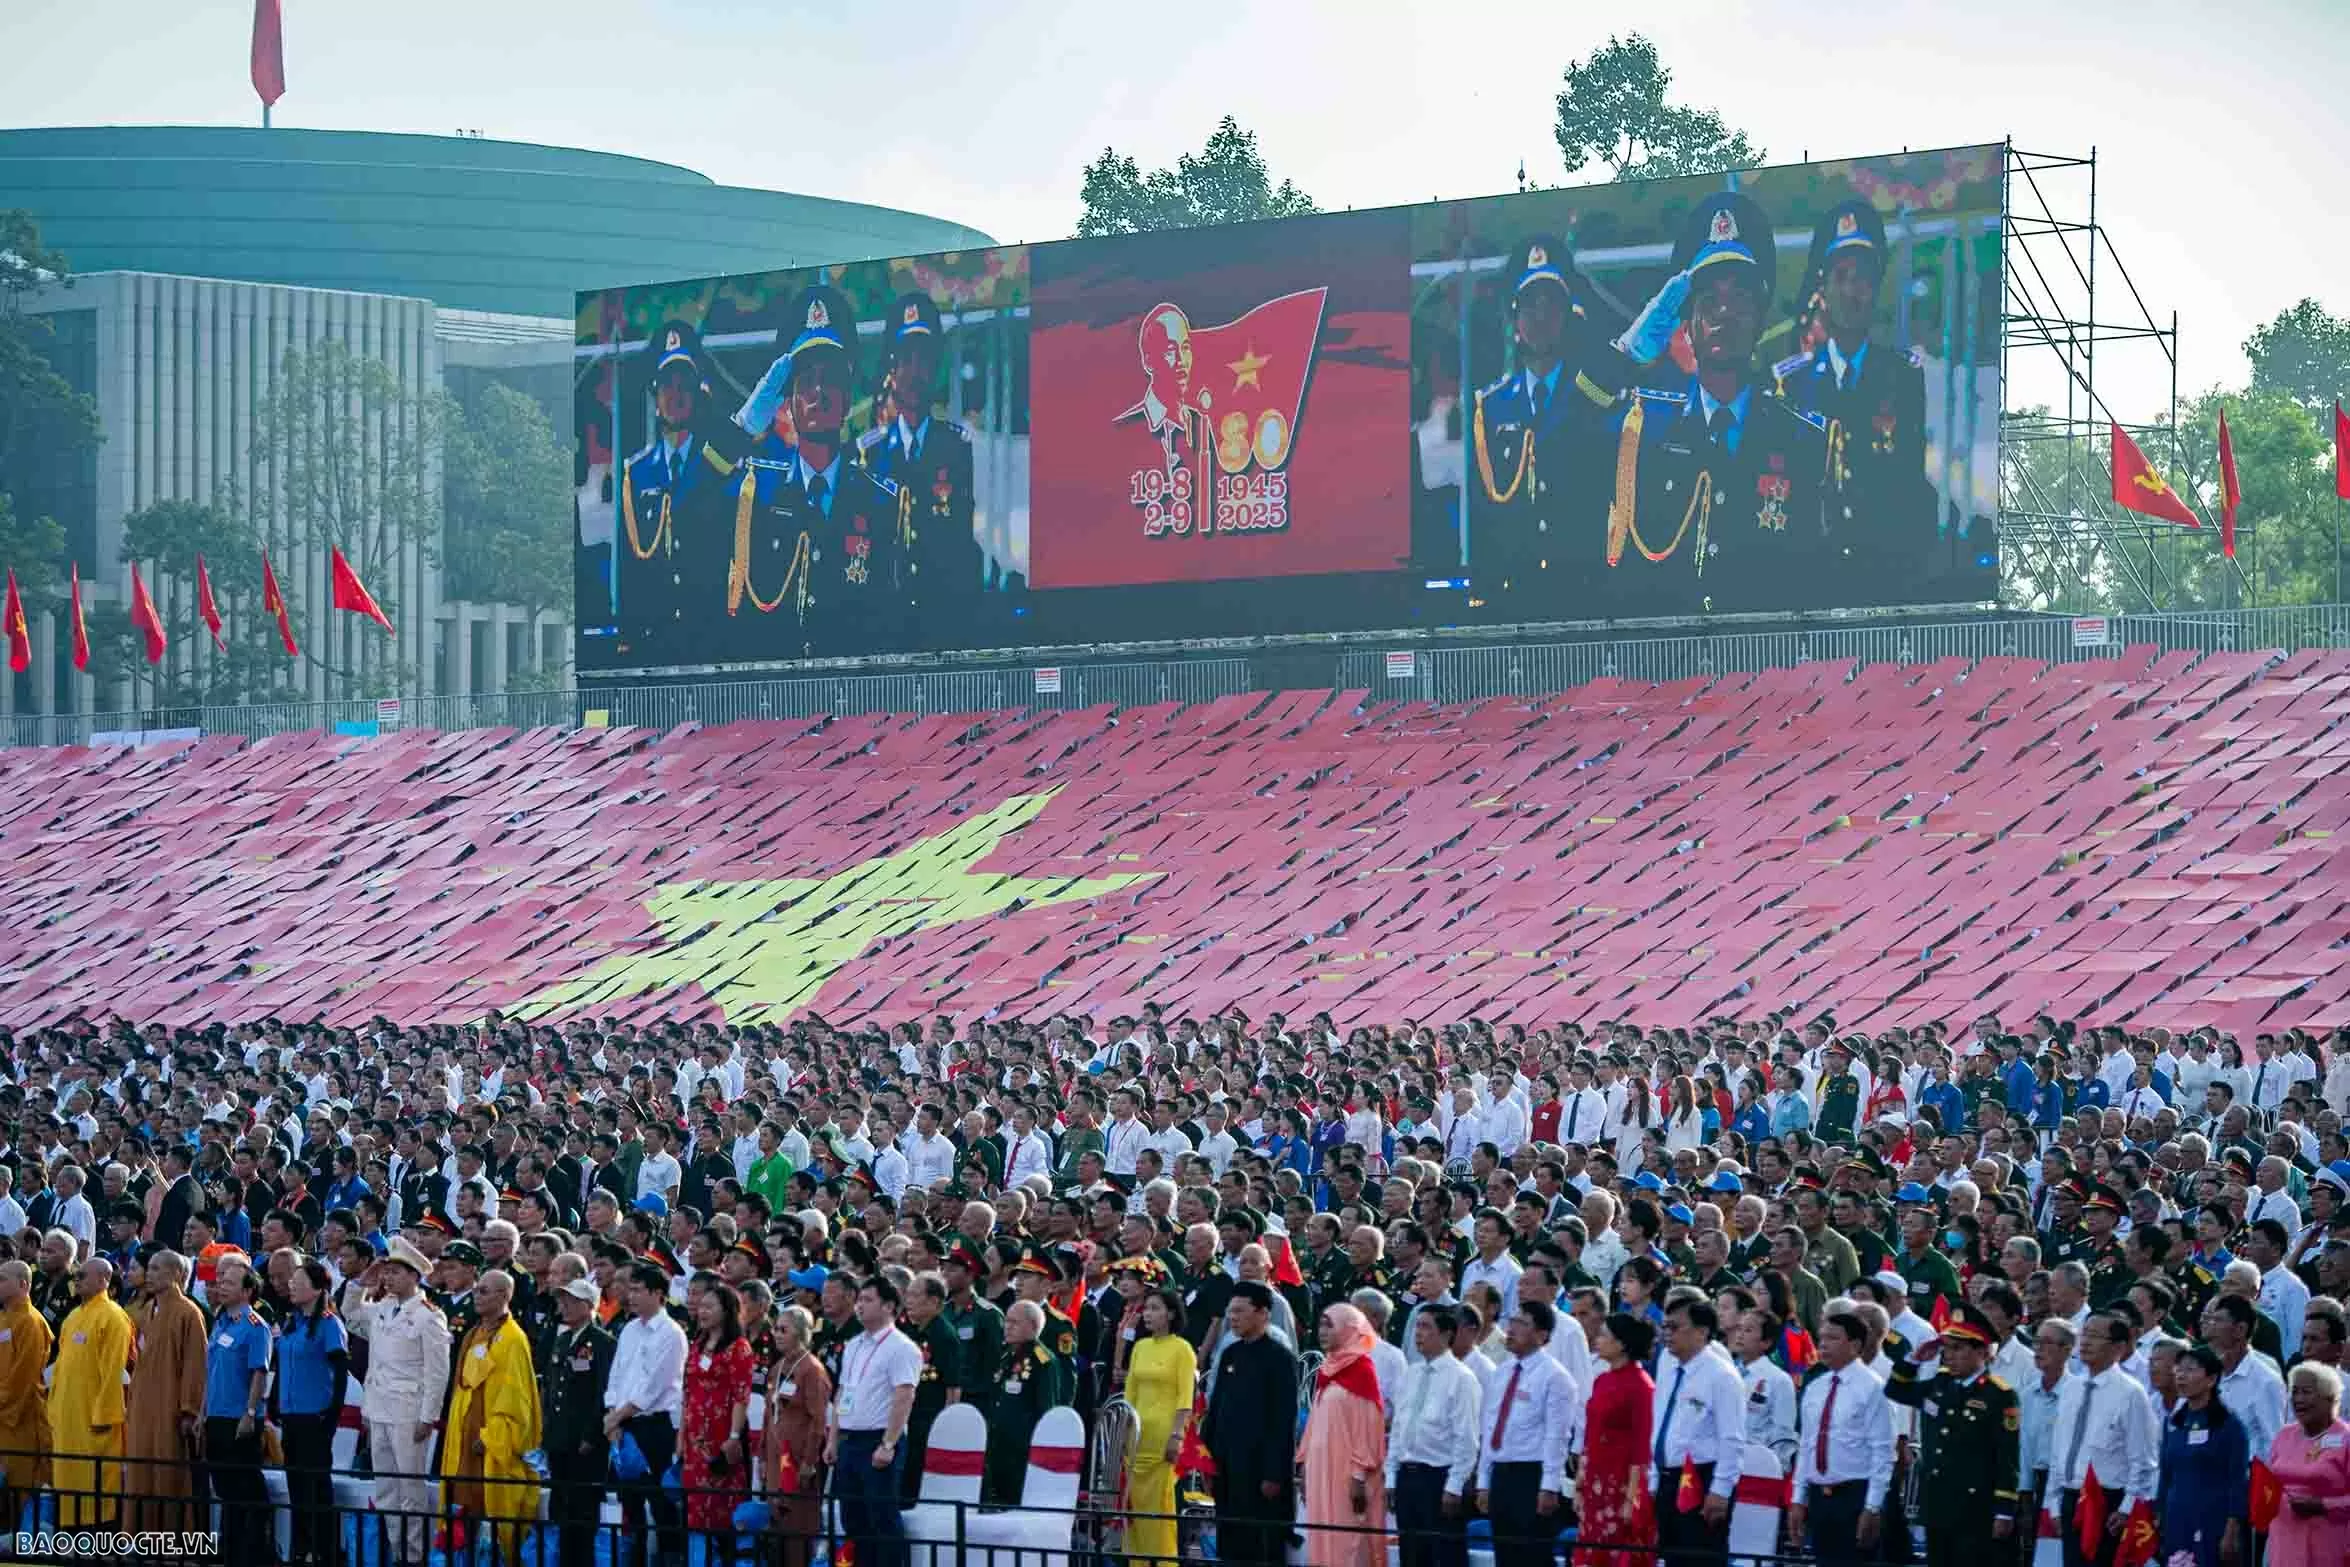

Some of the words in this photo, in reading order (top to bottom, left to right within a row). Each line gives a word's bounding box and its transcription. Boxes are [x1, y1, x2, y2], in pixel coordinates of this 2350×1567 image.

[1218, 408, 1289, 473] 80
[1131, 467, 1191, 503] 19-8
[1217, 472, 1288, 502] 1945
[1144, 500, 1192, 535] 2-9
[1217, 500, 1288, 531] 2025
